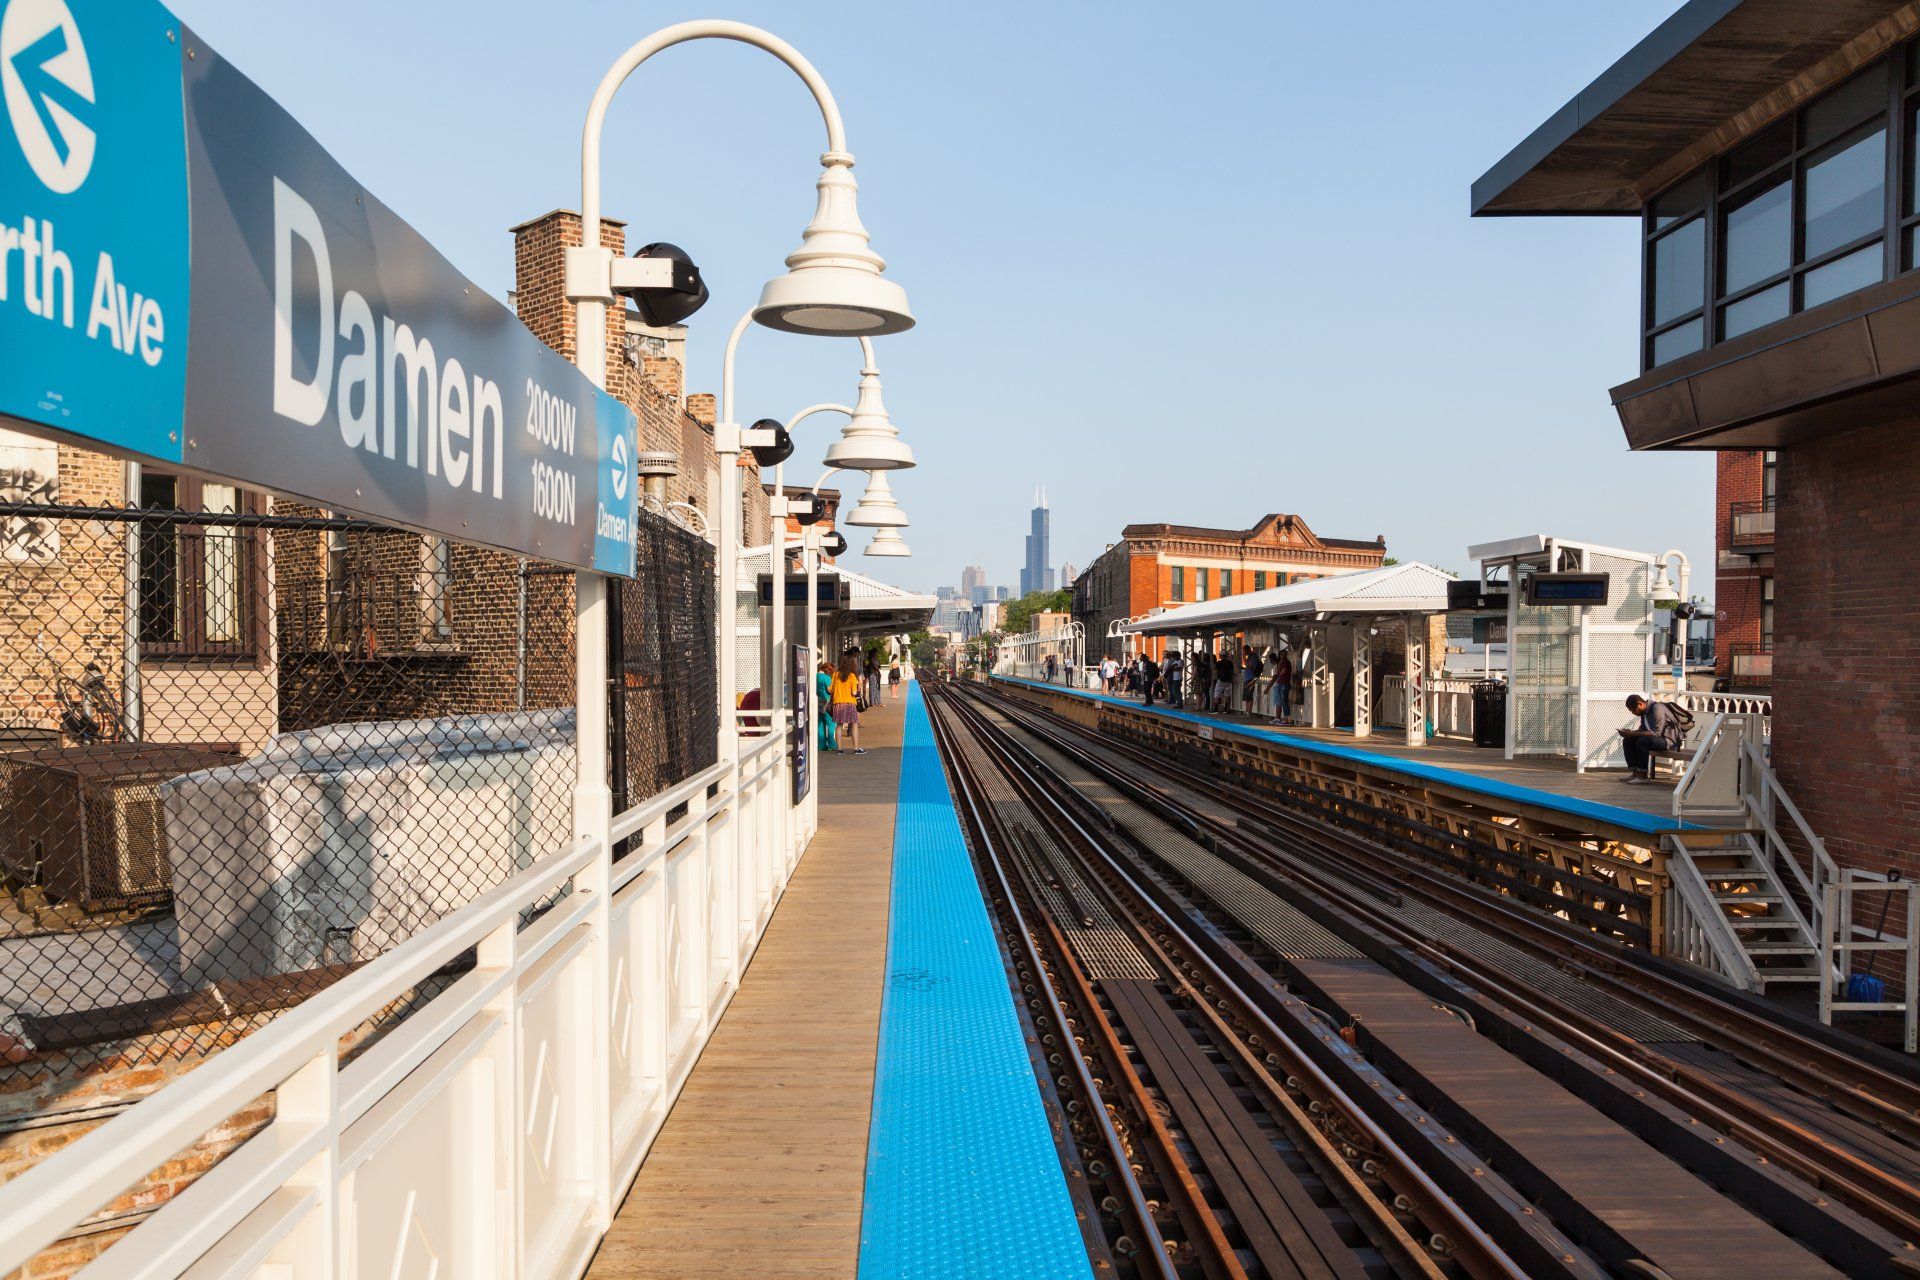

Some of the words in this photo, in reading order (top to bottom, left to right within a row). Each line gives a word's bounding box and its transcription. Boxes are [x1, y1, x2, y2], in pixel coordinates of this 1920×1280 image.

[86, 250, 164, 367] Ave
[273, 175, 504, 500] Damen
[526, 377, 577, 457] 2000W
[531, 457, 576, 527] 1600N
[597, 501, 627, 544] Damen
